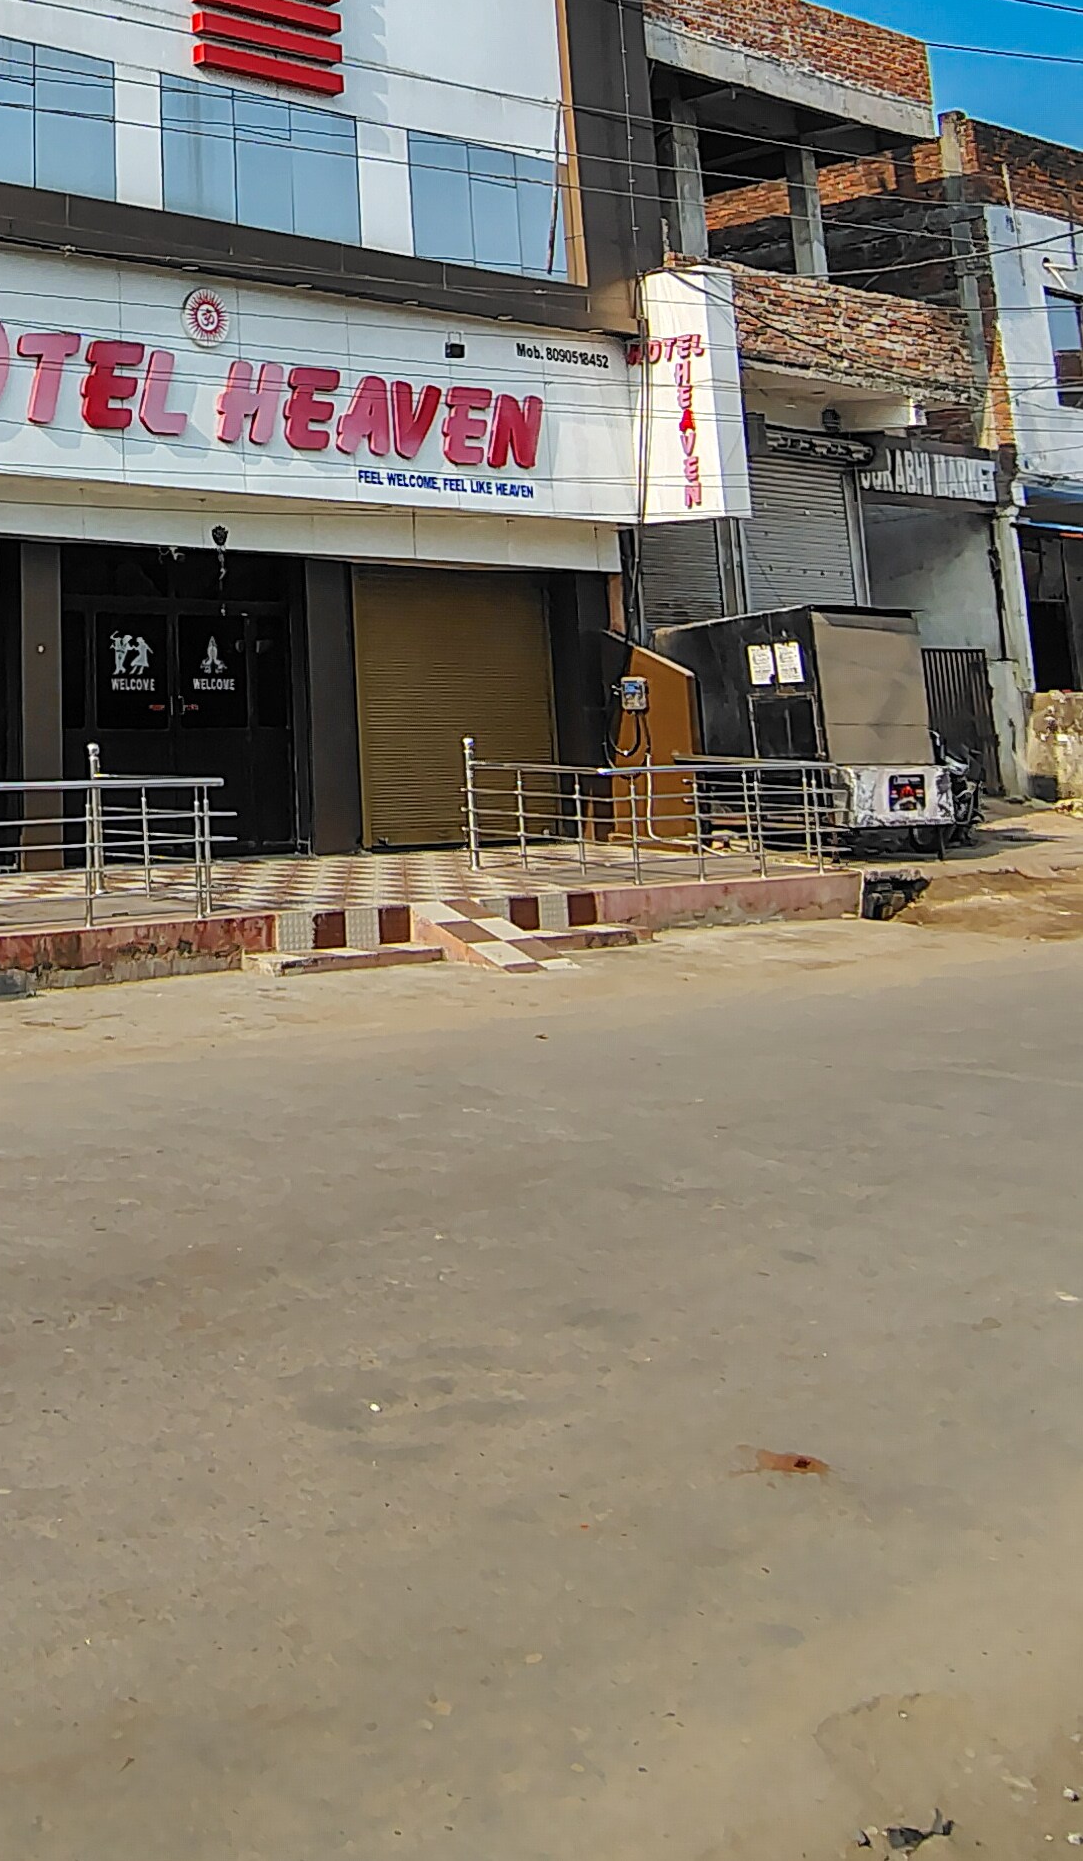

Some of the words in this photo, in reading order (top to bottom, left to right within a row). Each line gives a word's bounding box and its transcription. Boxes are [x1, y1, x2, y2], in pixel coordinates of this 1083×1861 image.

[516, 342, 544, 360] Mob.
[546, 347, 609, 369] 8090518452
[627, 334, 705, 365] HOTEL
[216, 360, 543, 468] HEAVEN
[674, 360, 702, 509] HEAVEN
[358, 470, 384, 485] FEEL
[387, 472, 441, 492] WELCOME,
[443, 478, 467, 492] FEEL
[470, 480, 493, 494] LIKE
[495, 483, 534, 498] HEAVEN
[111, 678, 155, 691] WELCOME
[193, 678, 235, 691] WELCOME
